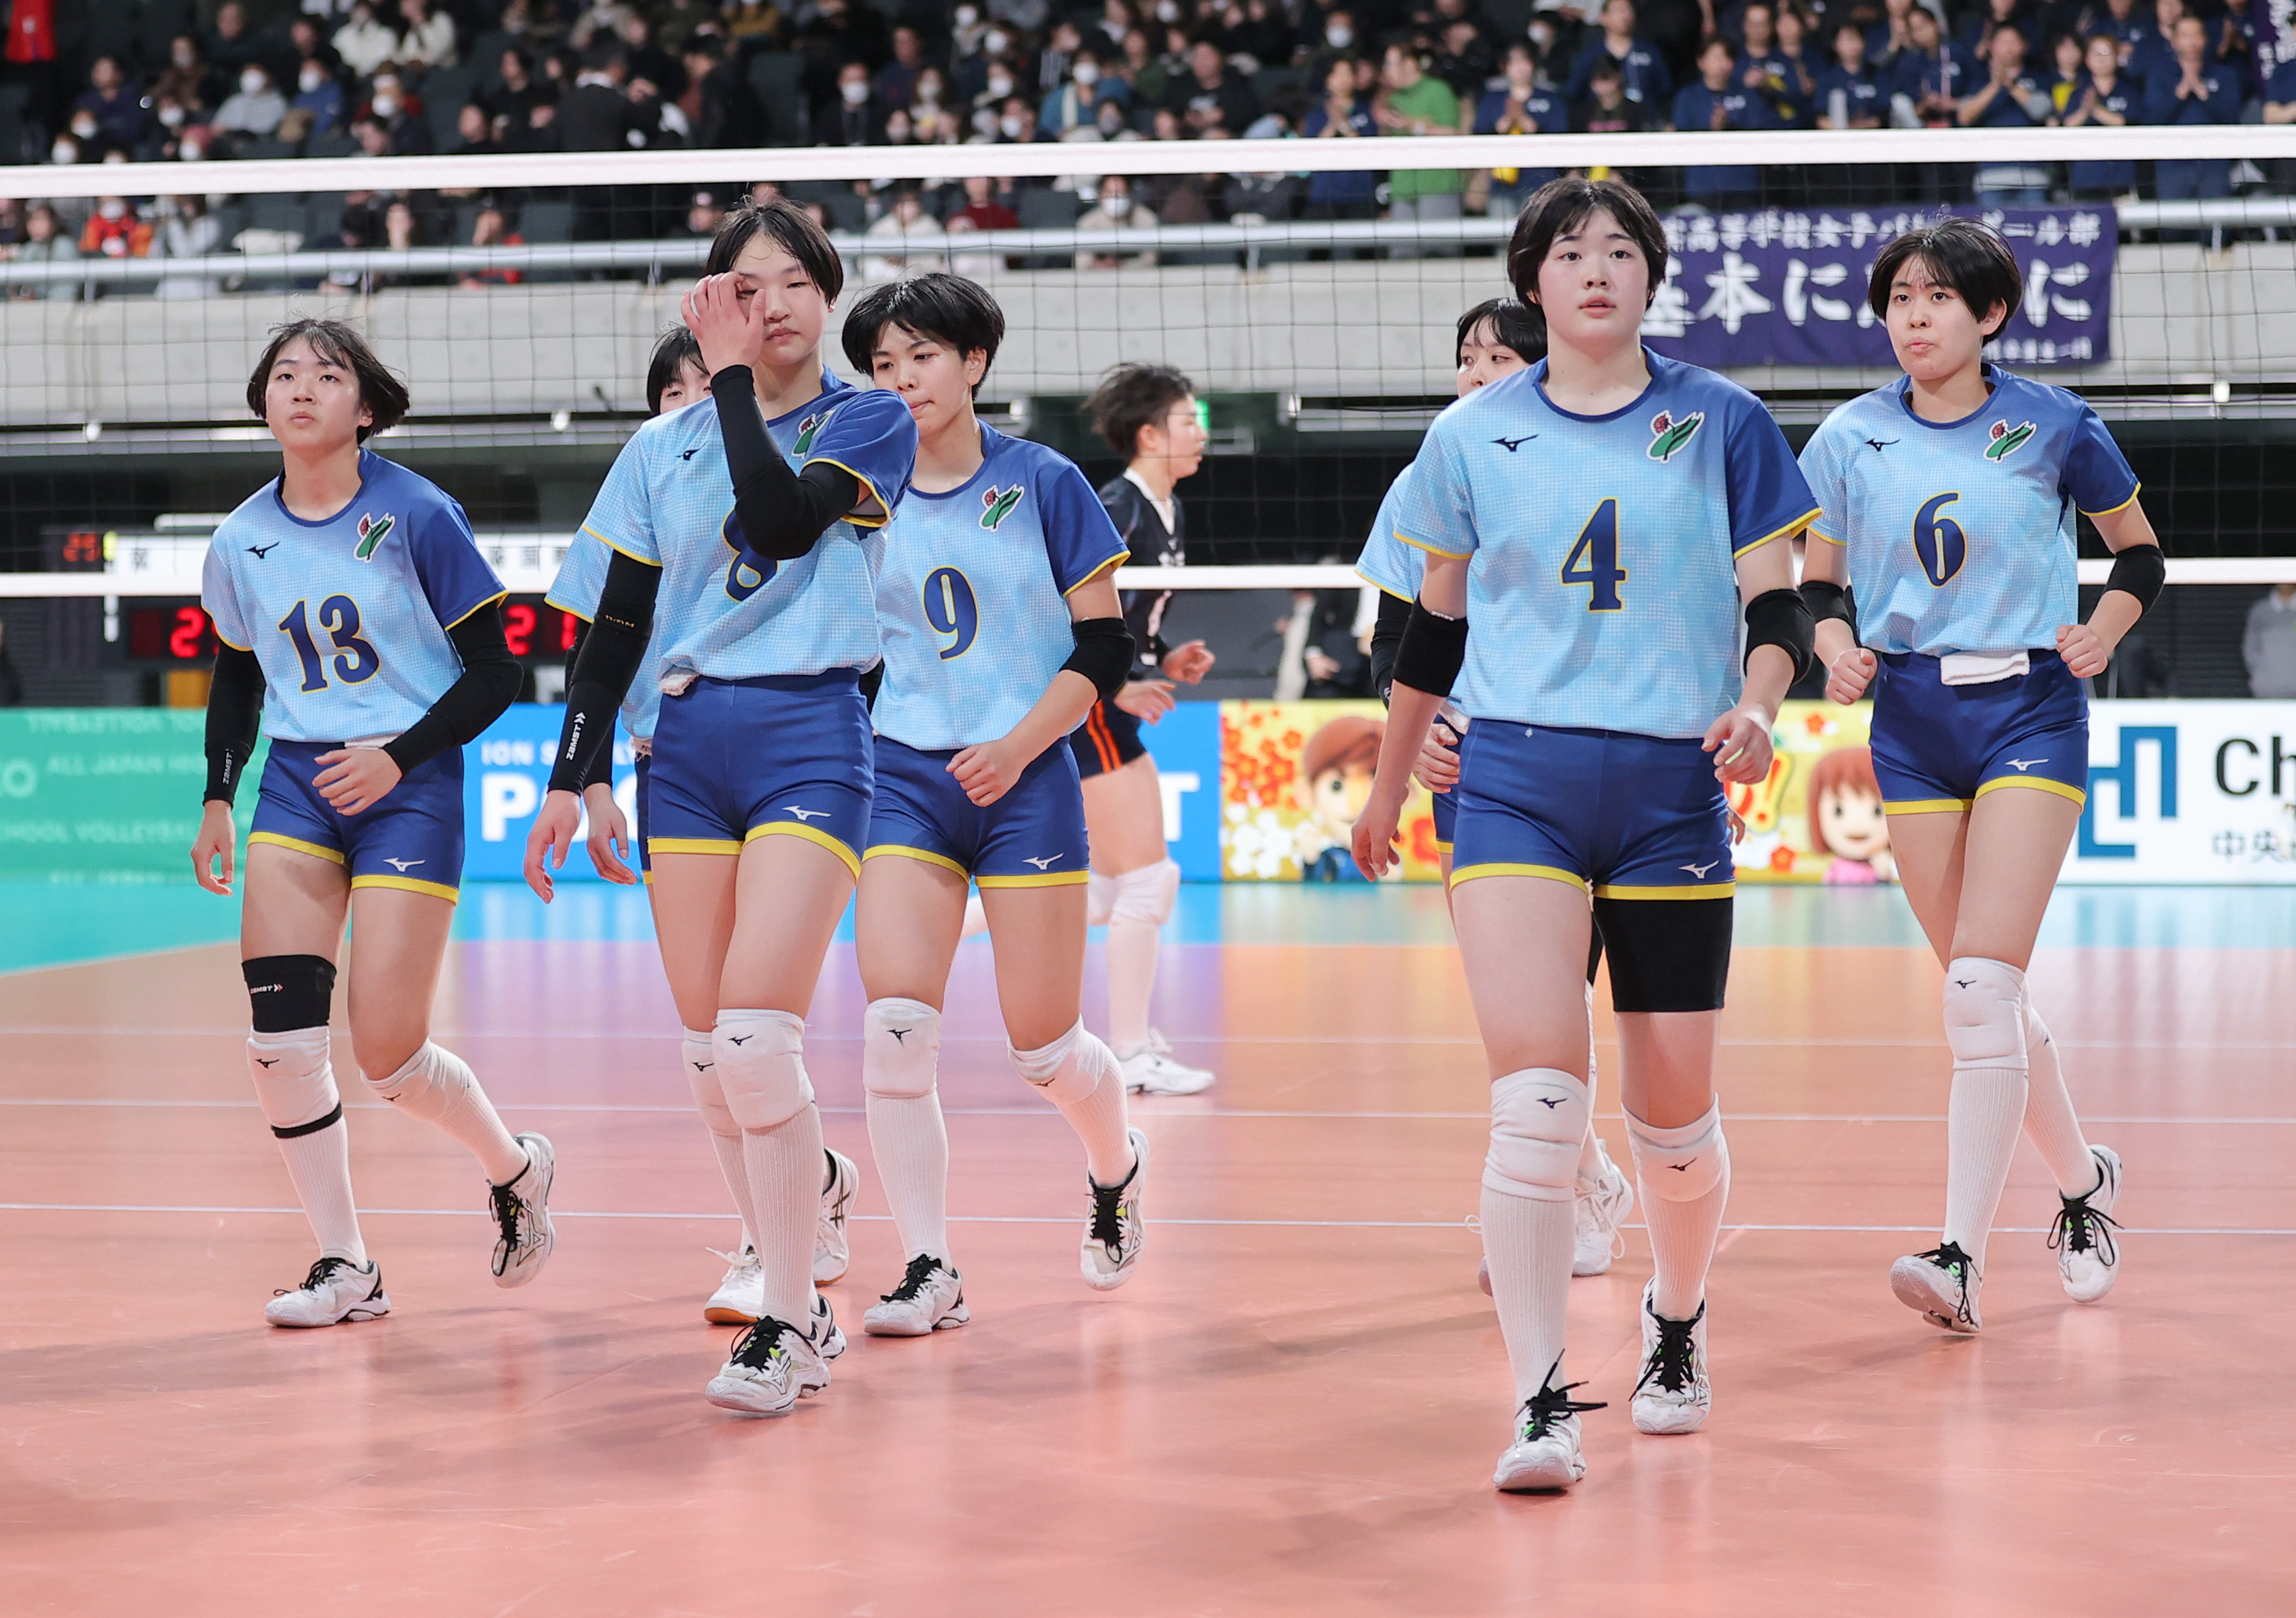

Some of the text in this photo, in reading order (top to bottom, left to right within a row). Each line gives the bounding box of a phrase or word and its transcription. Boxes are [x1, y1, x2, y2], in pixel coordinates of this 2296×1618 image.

[1561, 496, 1628, 612] 4
[1910, 491, 1968, 588] 6
[170, 606, 218, 658] 2
[277, 593, 382, 694] 13
[923, 564, 980, 661] 9
